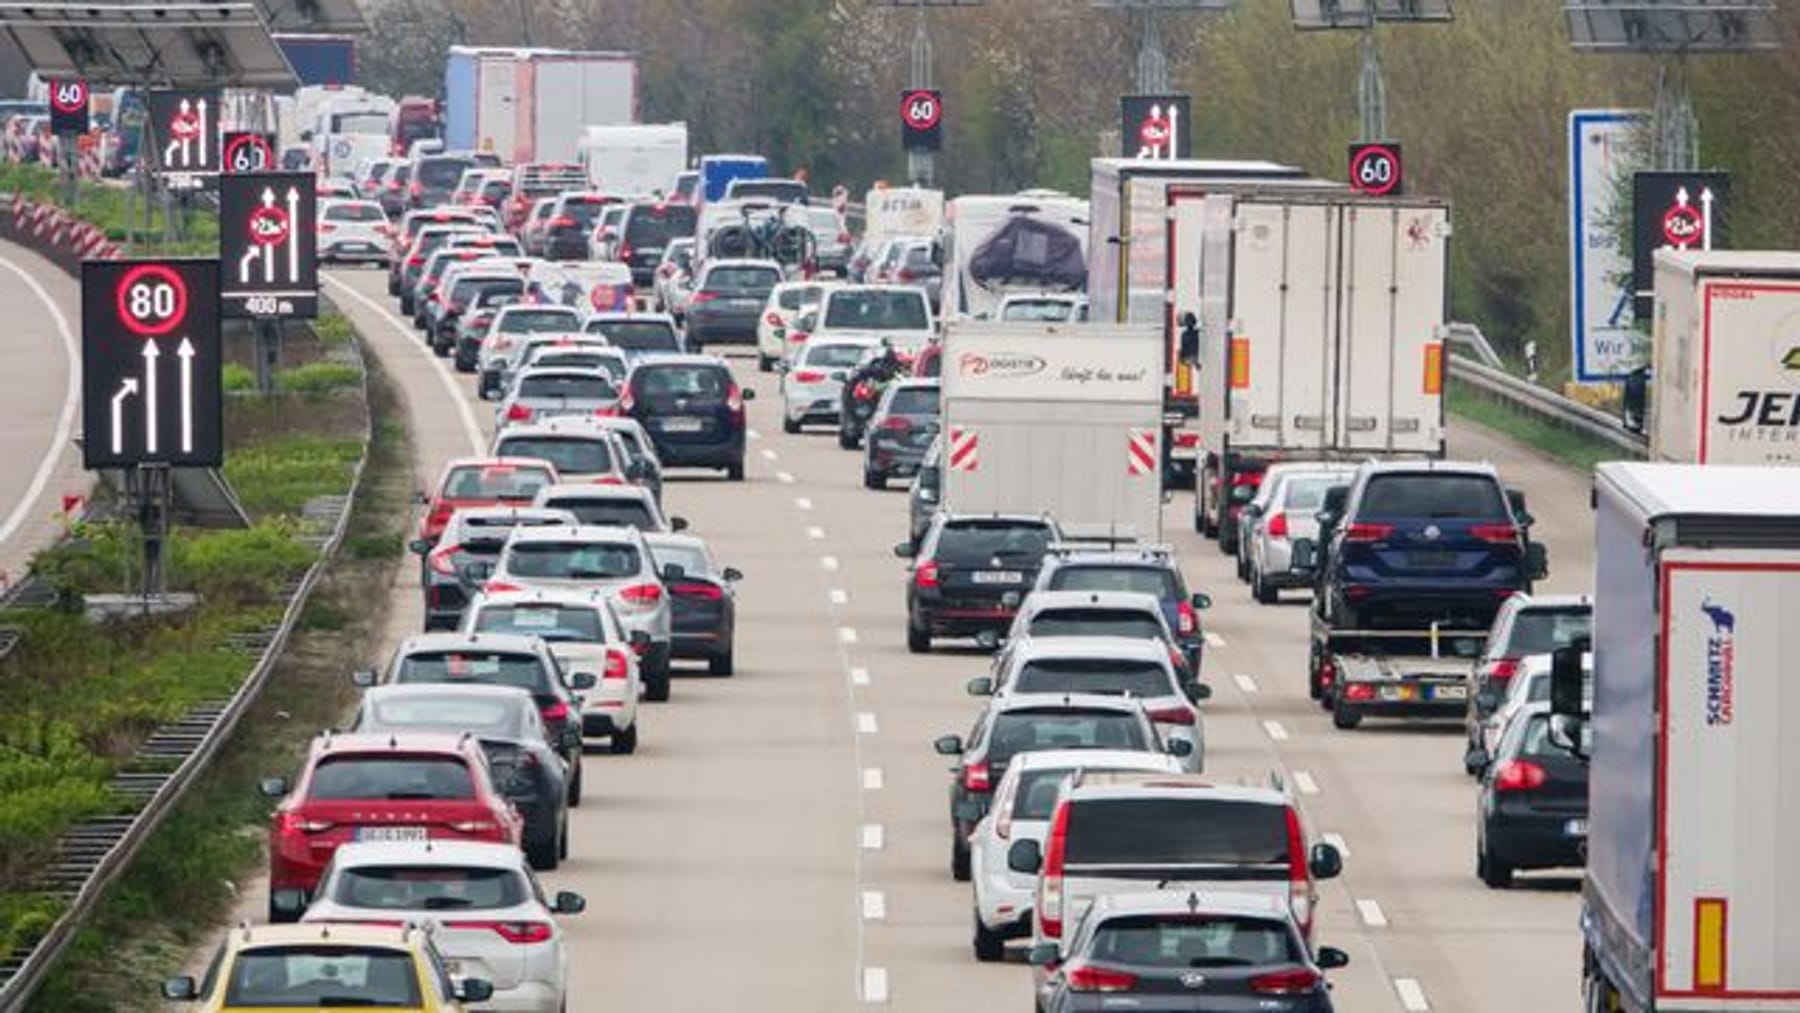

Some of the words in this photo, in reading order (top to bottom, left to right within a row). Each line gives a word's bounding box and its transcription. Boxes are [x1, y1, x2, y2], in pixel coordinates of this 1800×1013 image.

[58, 84, 80, 102] 60
[911, 101, 932, 119] 60
[1361, 157, 1390, 182] 60
[131, 283, 174, 319] 80
[245, 298, 277, 314] 400
[279, 301, 294, 313] m
[1707, 637, 1721, 725] SCHMITZ
